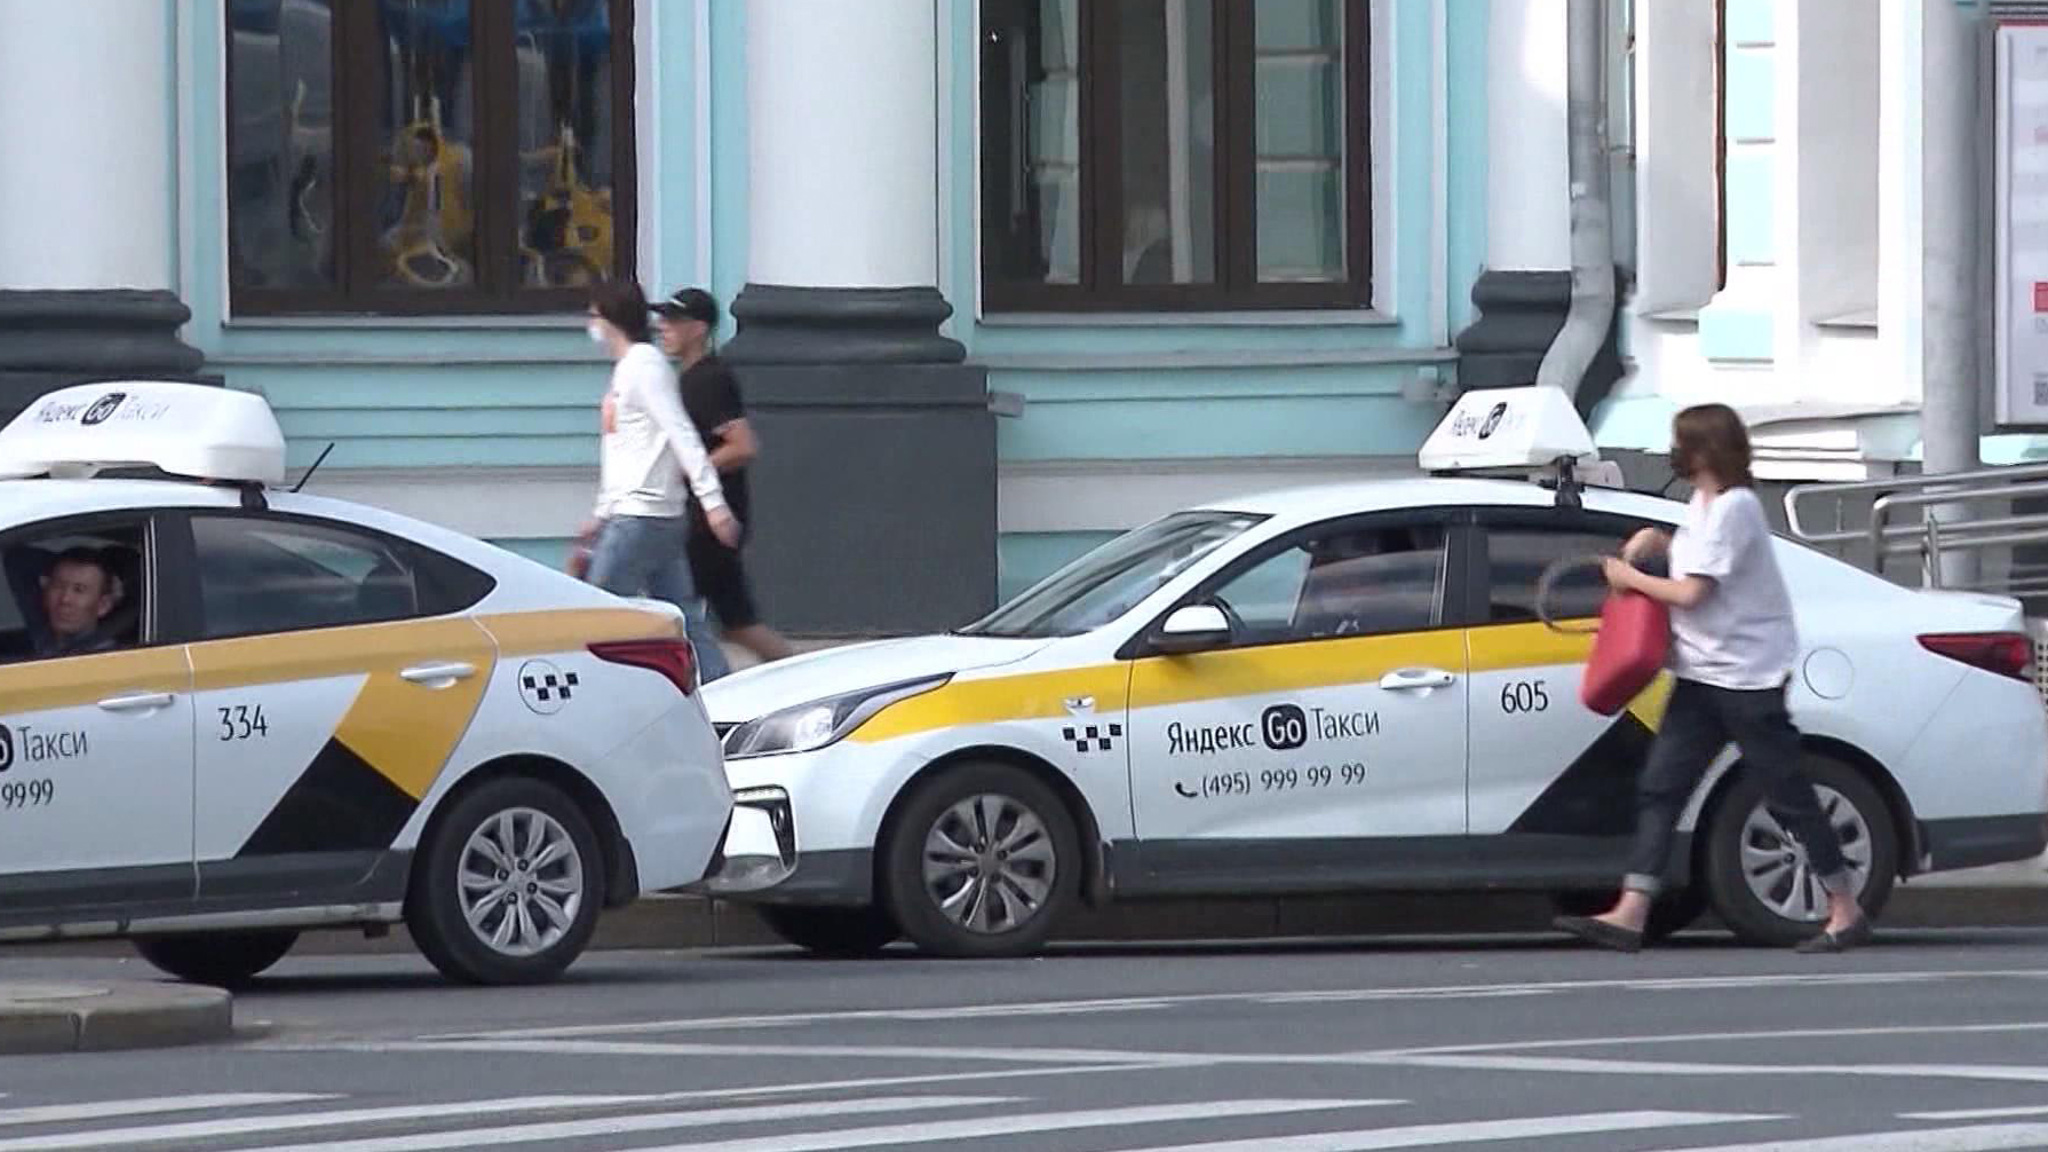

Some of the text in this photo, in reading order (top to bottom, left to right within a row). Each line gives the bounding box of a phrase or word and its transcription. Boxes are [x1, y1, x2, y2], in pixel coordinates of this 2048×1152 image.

[1501, 680, 1548, 714] 605
[217, 704, 269, 741] 334
[1167, 708, 1380, 754] Яндекс Go Такси
[17, 725, 88, 762] Такси
[1202, 762, 1366, 798] (495) 999 99 99
